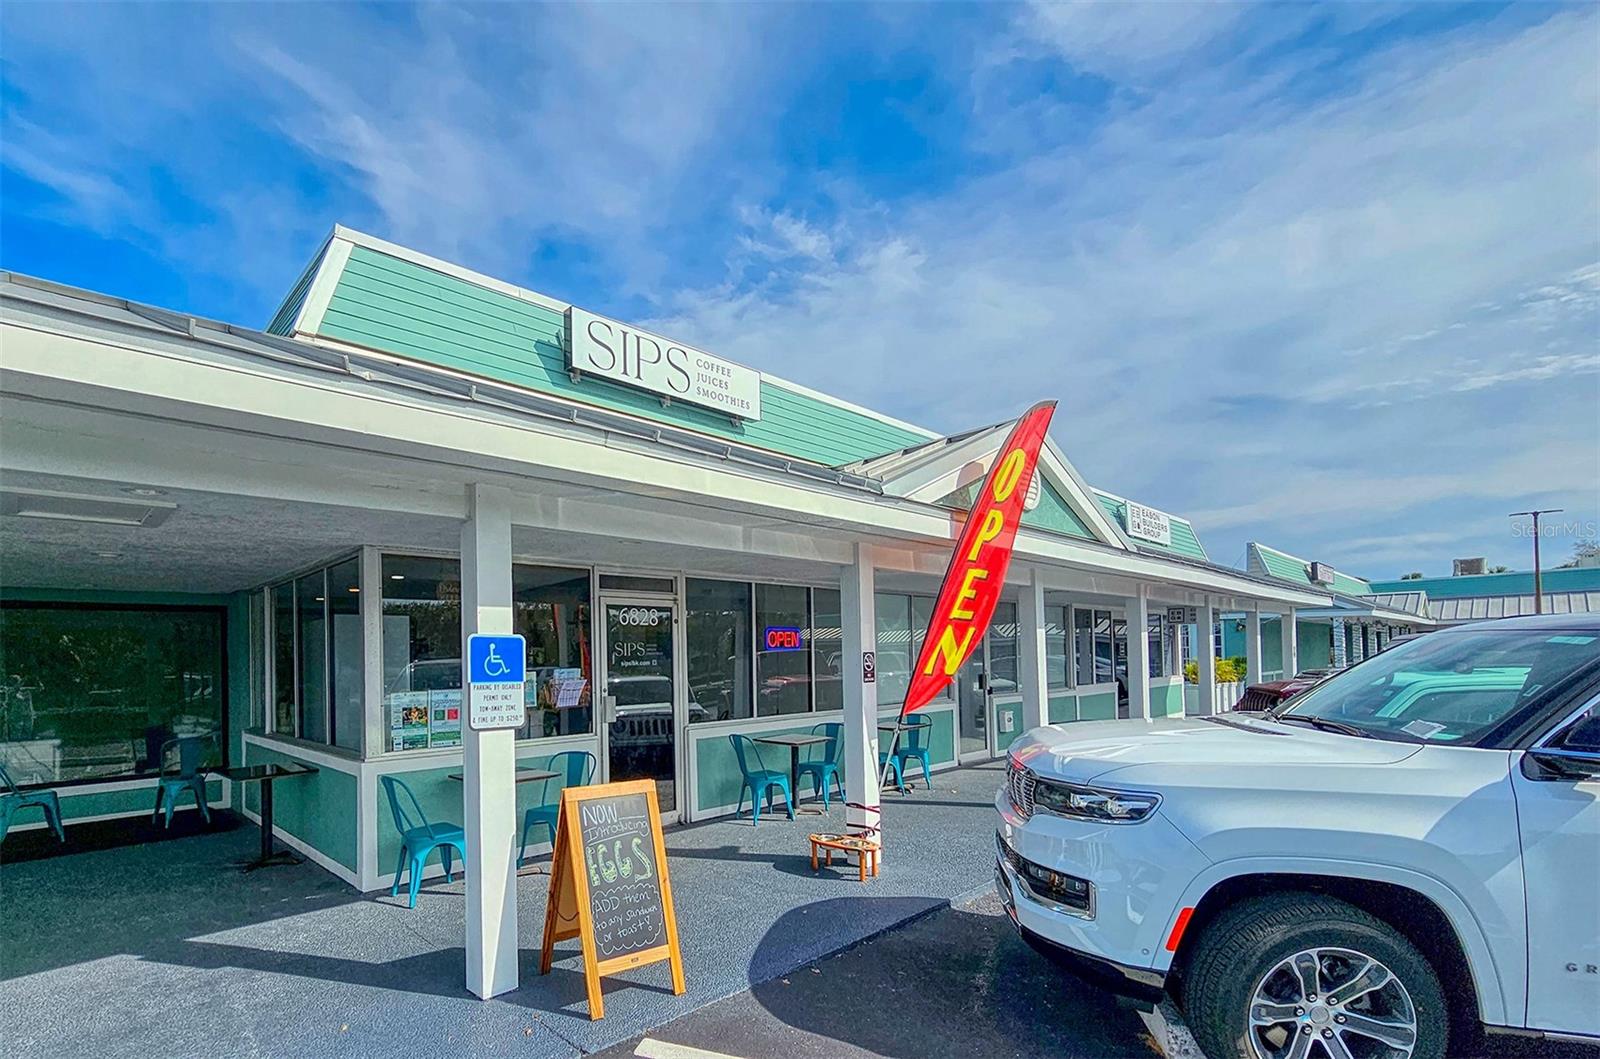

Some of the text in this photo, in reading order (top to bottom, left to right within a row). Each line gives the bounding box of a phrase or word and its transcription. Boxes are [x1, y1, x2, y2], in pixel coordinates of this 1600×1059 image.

[587, 320, 690, 394] SIPS
[696, 358, 732, 378] COFFEE
[696, 373, 729, 390] JUICES
[696, 387, 751, 410] SMOOTHIES
[1142, 509, 1160, 522] EASON
[1142, 518, 1168, 533] BUILDERS
[1143, 527, 1161, 539] GROUP
[924, 448, 1026, 676] OPEN
[619, 607, 659, 626] 6828
[767, 631, 799, 649] OPEN
[614, 641, 646, 657] SIPS
[473, 683, 492, 691] PARKING
[483, 694, 499, 702] PERMIT
[582, 803, 618, 826] NOW
[585, 837, 653, 886] EGGS
[595, 891, 651, 918] ADD them
[596, 921, 608, 931] to
[607, 914, 623, 926] any
[603, 931, 612, 943] or
